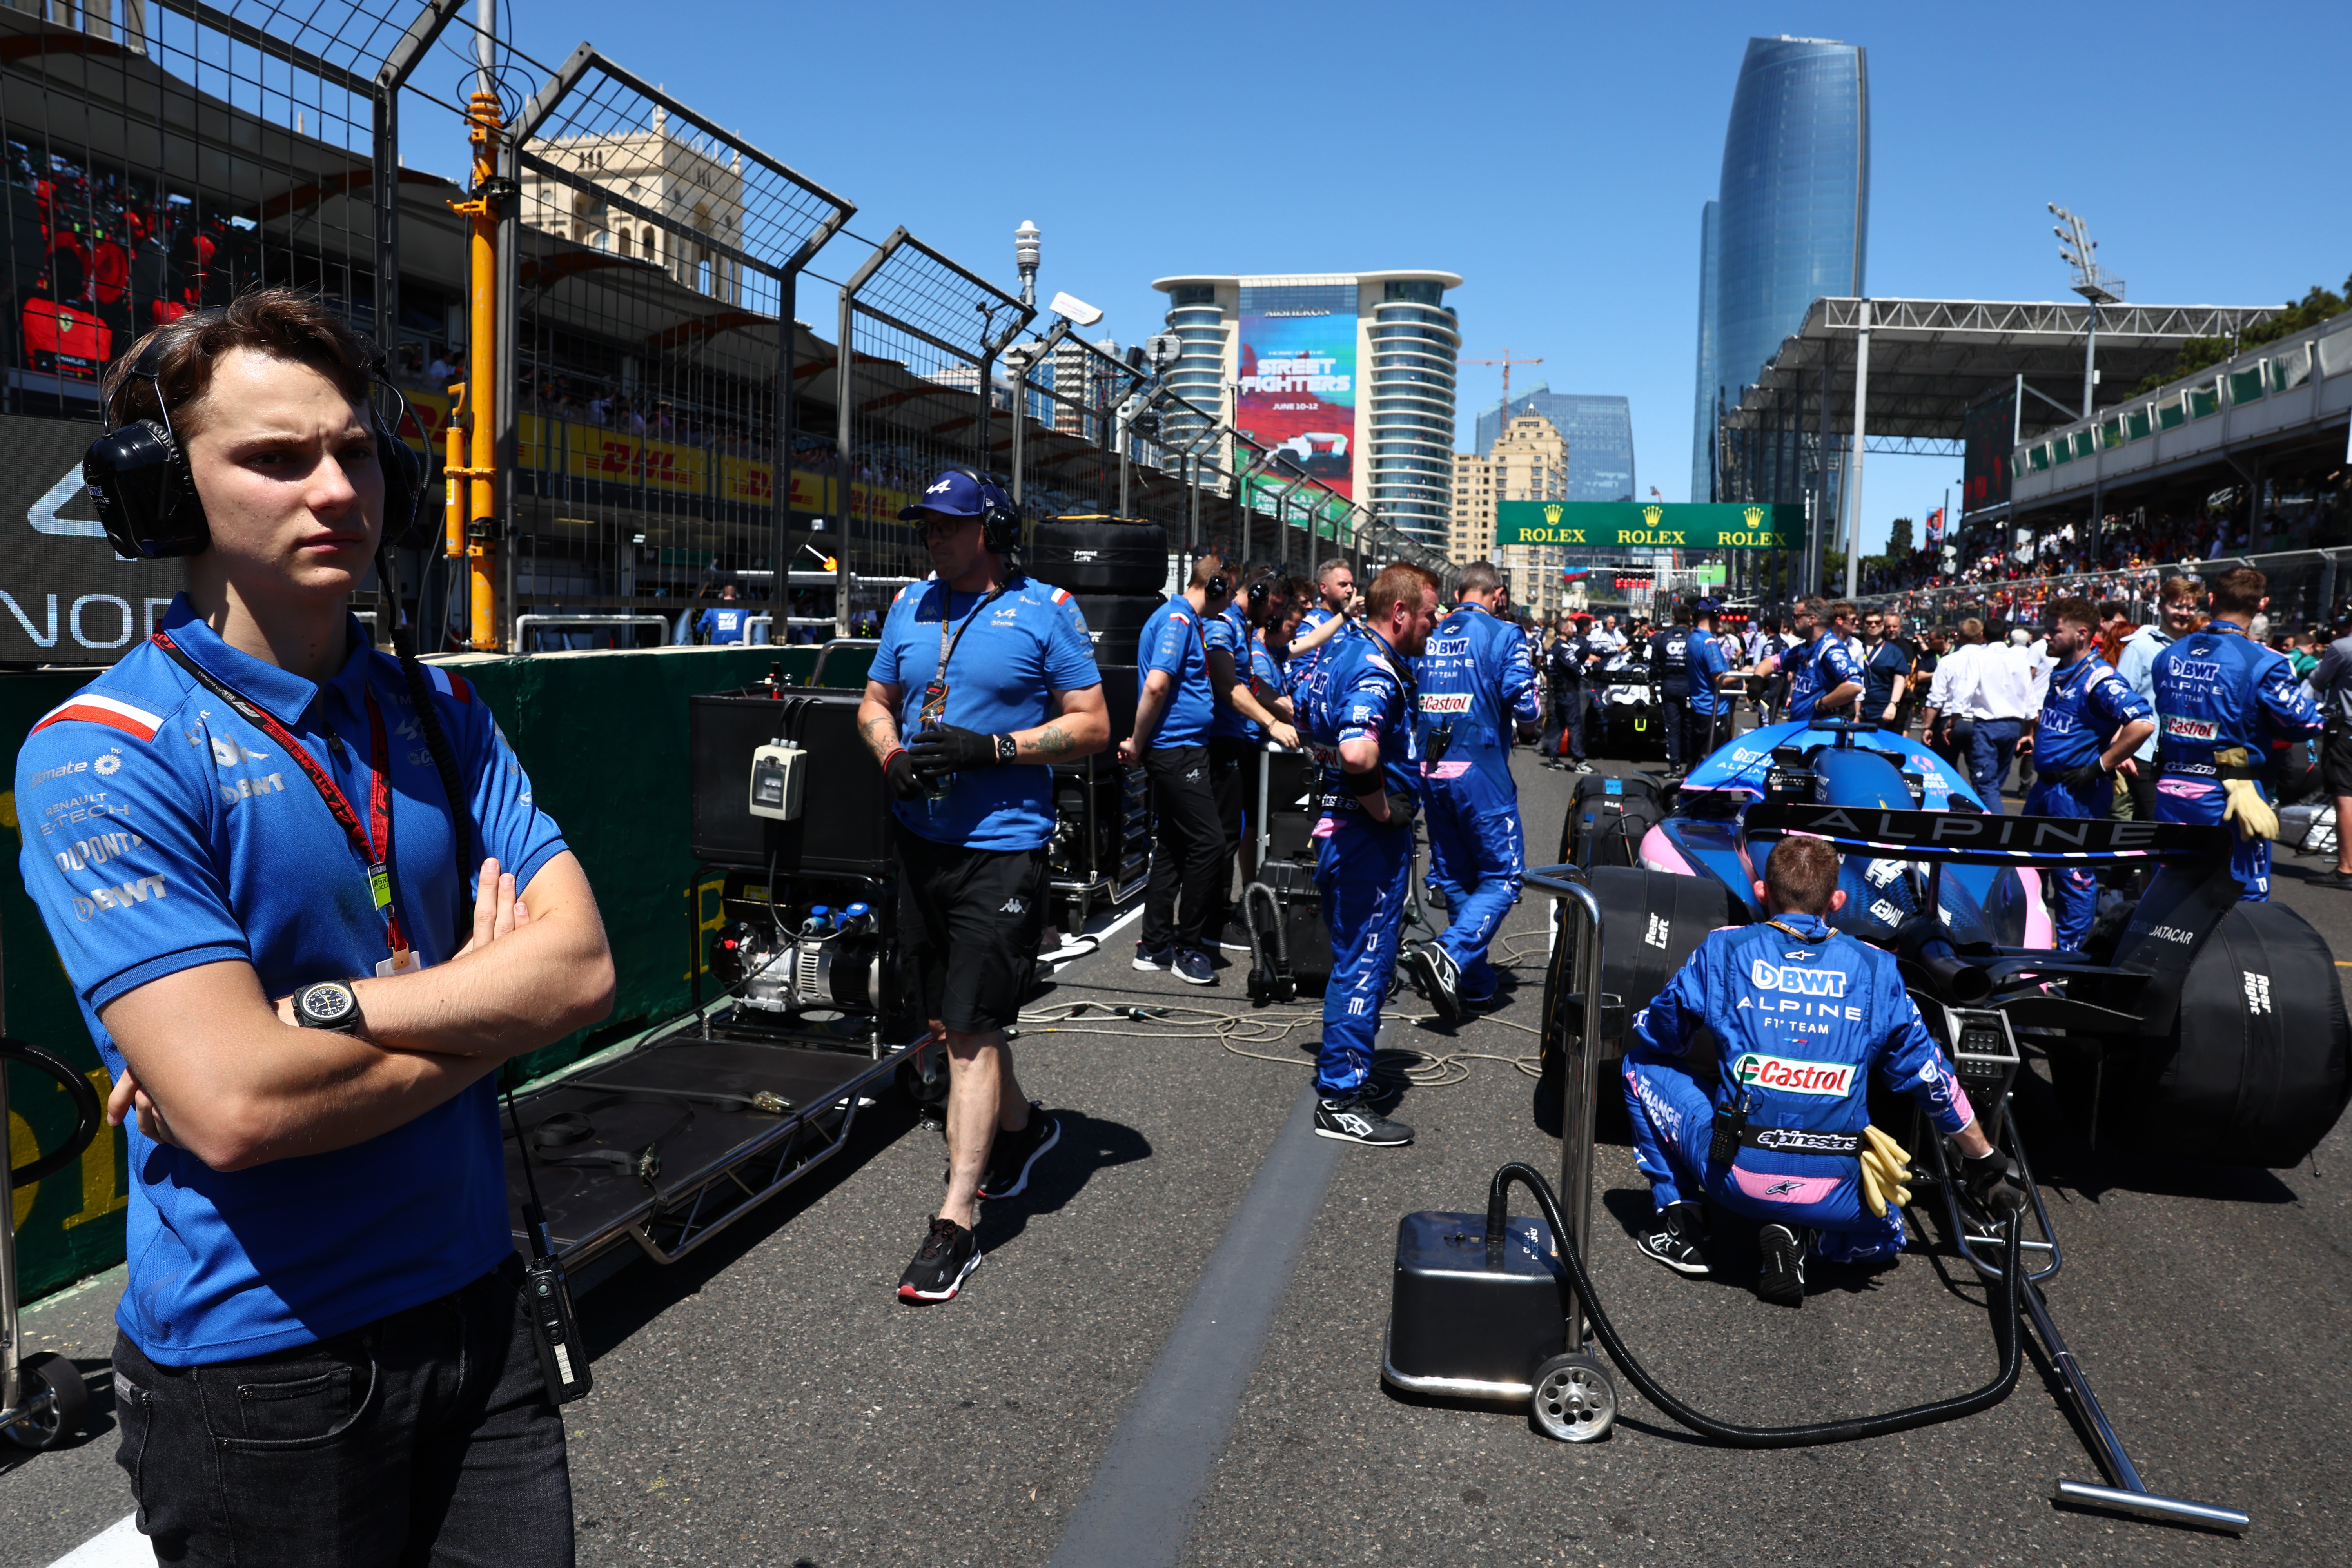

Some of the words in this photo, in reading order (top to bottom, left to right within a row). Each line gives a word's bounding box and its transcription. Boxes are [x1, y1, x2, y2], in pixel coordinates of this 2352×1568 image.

[1265, 307, 1330, 317] ABSHERON
[1257, 358, 1336, 376] STREET
[1243, 375, 1351, 392] FIGHTERS
[601, 442, 679, 482] DHL
[90, 486, 103, 496] BWT
[745, 470, 803, 503] DL
[1518, 528, 1586, 543] ROLEX
[1617, 529, 1686, 545] ROLEX
[1717, 532, 1787, 546] ROLEX
[1436, 637, 1470, 656] BWT
[1418, 659, 1475, 668] ALPINE
[2180, 660, 2220, 681] BWT
[1359, 687, 1387, 699] E-TEC
[2161, 680, 2224, 695] ALPINE
[2184, 694, 2203, 703] TEAM
[1426, 695, 1467, 710] Castrol
[263, 722, 295, 749] 2022
[2169, 718, 2214, 737] Castrol
[291, 748, 333, 800] PITLANE
[1717, 762, 1766, 775] ALPIN
[1923, 773, 1945, 782] NGE
[239, 772, 285, 799] BWT
[45, 793, 107, 817] RENAULT
[40, 804, 129, 837] E-TECH
[1807, 808, 2159, 846] ALPINE
[55, 833, 130, 873] DUPONT
[90, 873, 168, 913] BWT
[1645, 912, 1659, 946] Rear
[1655, 919, 1670, 949] Left
[2129, 920, 2194, 945] EURODATACAR
[1348, 886, 1389, 1016] ALPINE
[1779, 966, 1847, 998] BWT
[2243, 970, 2261, 1015] Right
[2256, 973, 2271, 1013] Rear
[1737, 996, 1861, 1021] ALPINE
[1789, 1021, 1829, 1034] TEAM
[1760, 1060, 1847, 1091] Castrol
[1637, 1083, 1682, 1130] CHANGE
[1757, 1129, 1858, 1151] alpinestars
[1530, 1227, 1539, 1243] ONLY
